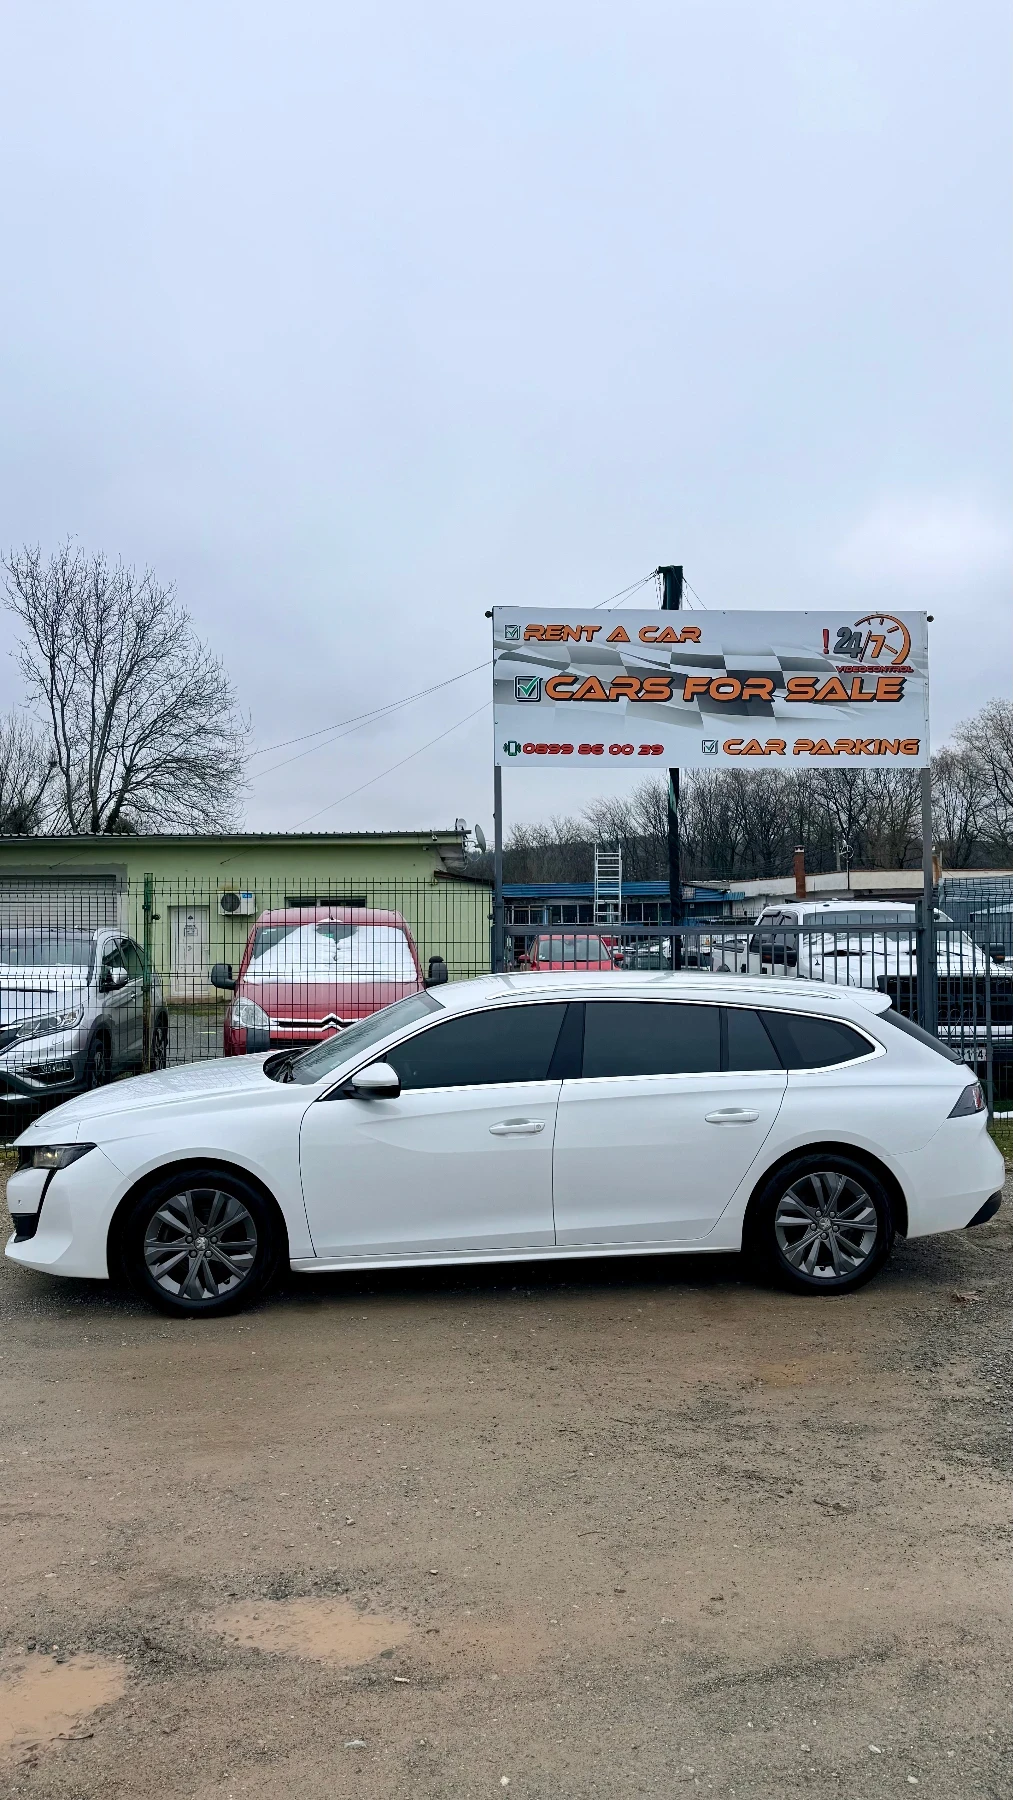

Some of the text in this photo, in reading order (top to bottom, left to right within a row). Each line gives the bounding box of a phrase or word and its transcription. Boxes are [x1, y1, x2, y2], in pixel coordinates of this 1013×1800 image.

[523, 624, 702, 643] RENT A CAR
[835, 665, 914, 673] VIDEOCONTROL
[545, 675, 905, 702] CARS FOR SALE
[522, 742, 665, 756] 0899 86 00 39
[722, 738, 921, 755] CAR PARKING
